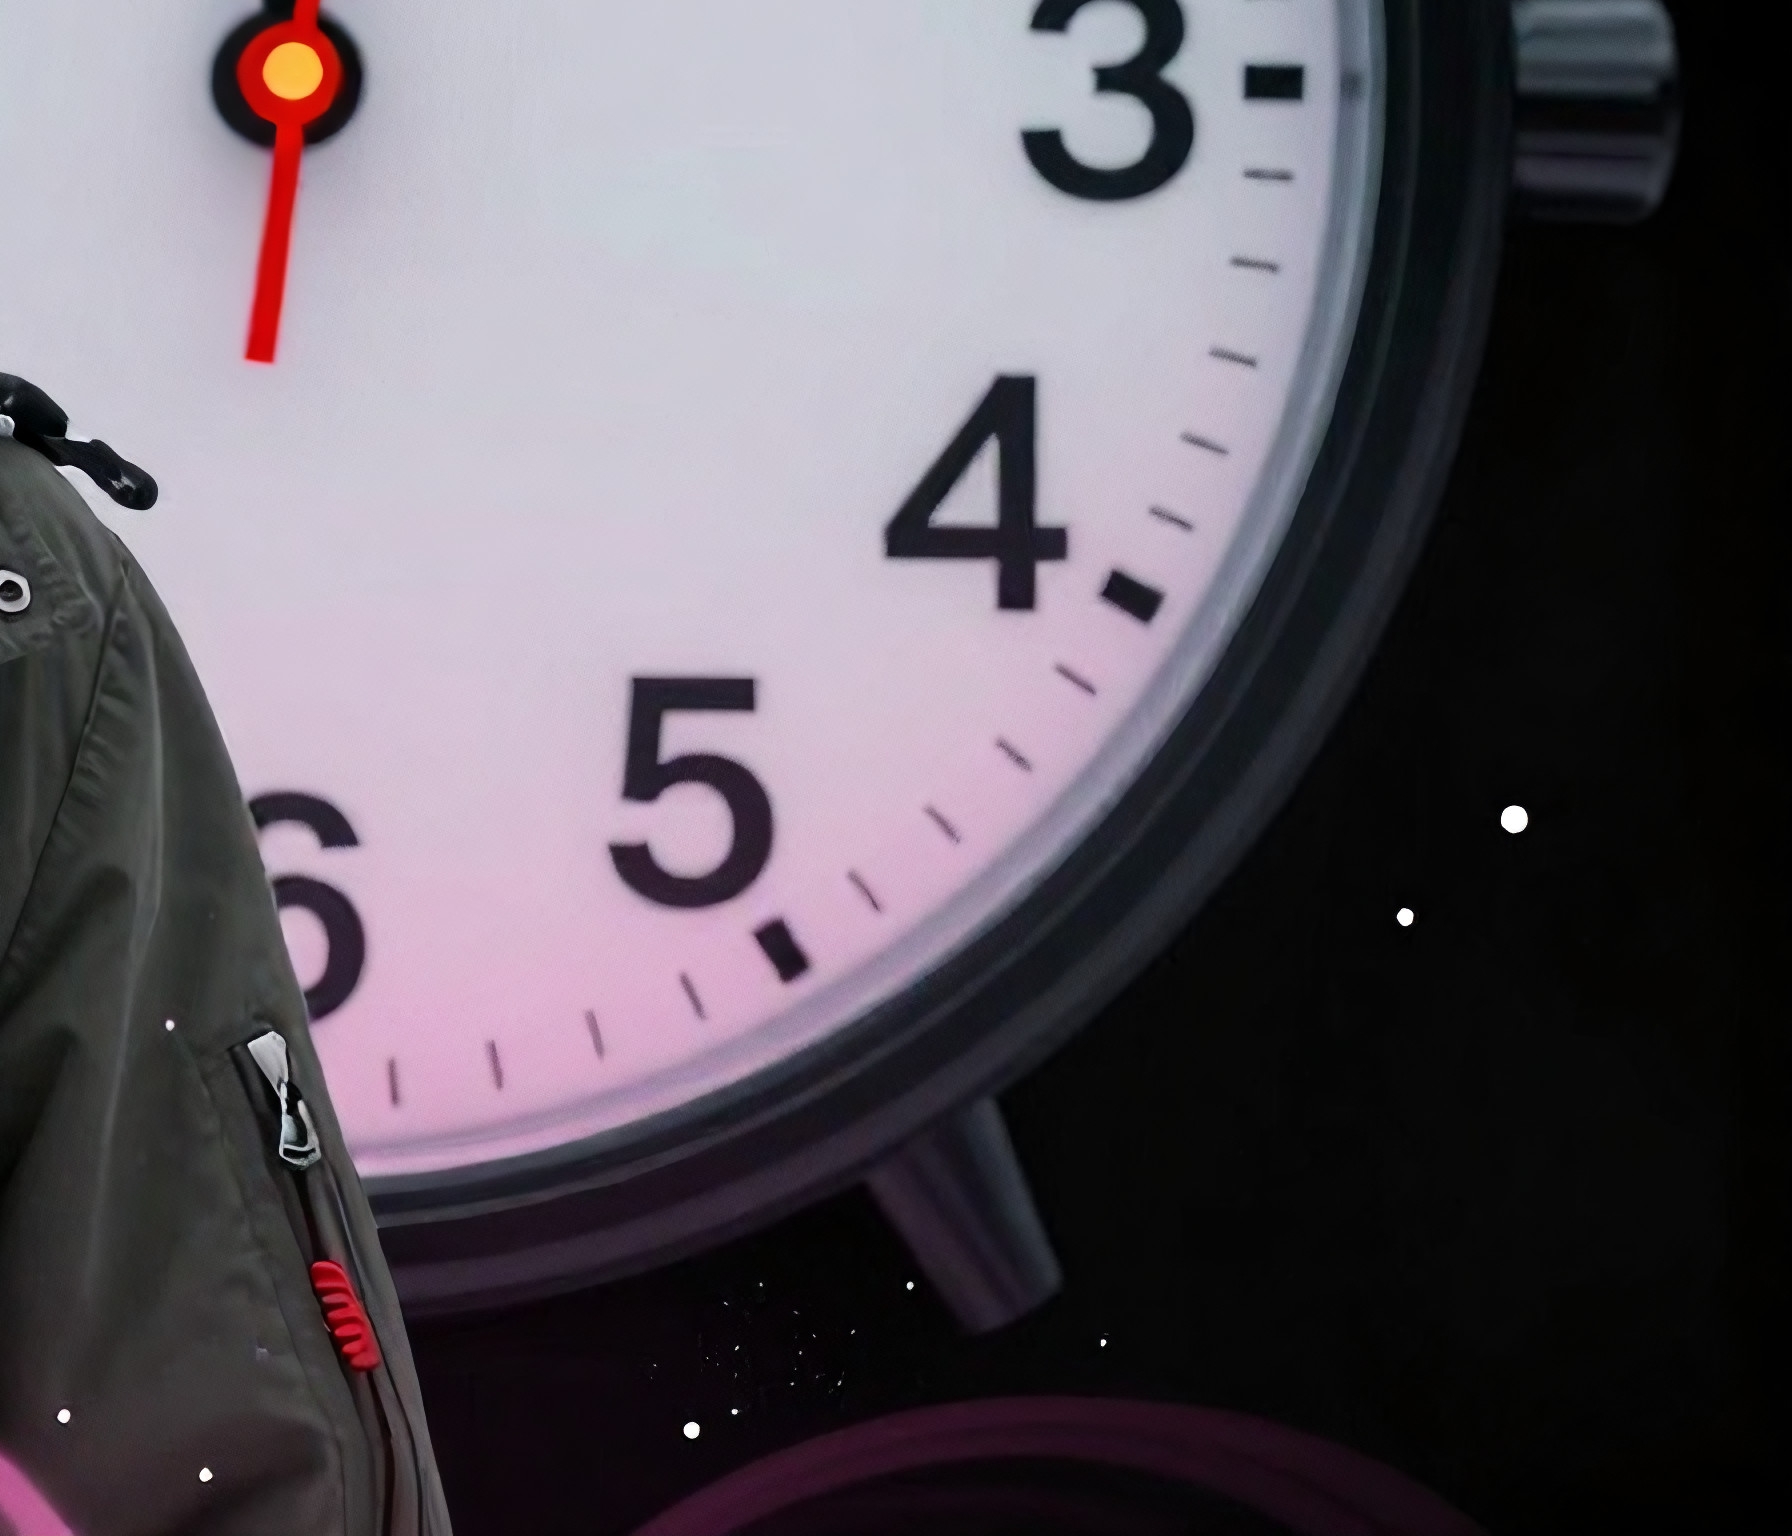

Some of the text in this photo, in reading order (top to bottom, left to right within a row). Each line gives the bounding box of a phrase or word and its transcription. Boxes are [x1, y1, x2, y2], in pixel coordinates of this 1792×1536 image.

[883, 374, 1069, 612] 4
[248, 791, 367, 1021] 6
[607, 676, 775, 910] 5
